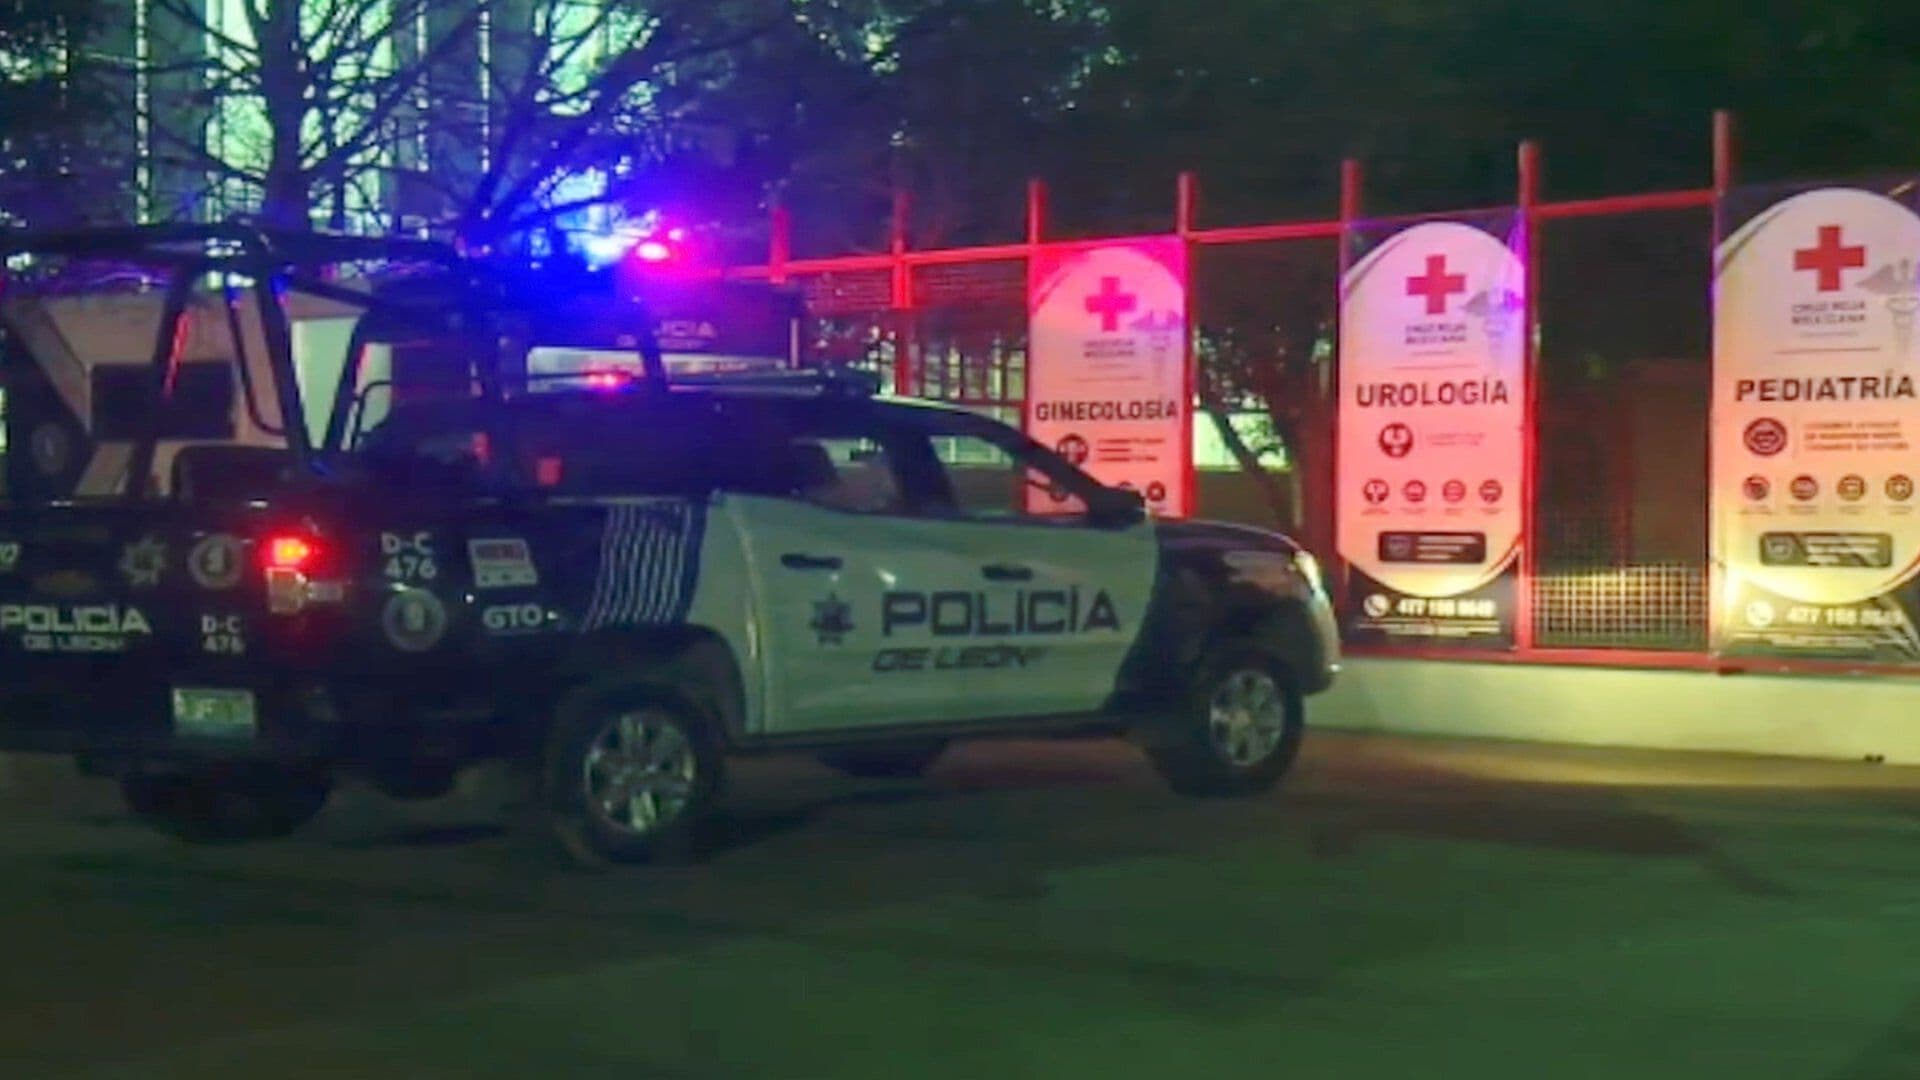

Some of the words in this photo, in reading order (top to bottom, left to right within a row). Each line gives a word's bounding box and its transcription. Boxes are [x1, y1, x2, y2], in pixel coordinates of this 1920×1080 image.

[1356, 376, 1508, 407] UROLOGÍA
[1735, 371, 1917, 402] PEDIATRÍA
[1035, 396, 1178, 421] GINECOLOGÍA
[386, 555, 437, 579] 476
[482, 604, 543, 630] GTO
[882, 585, 1120, 636] POLICÍA
